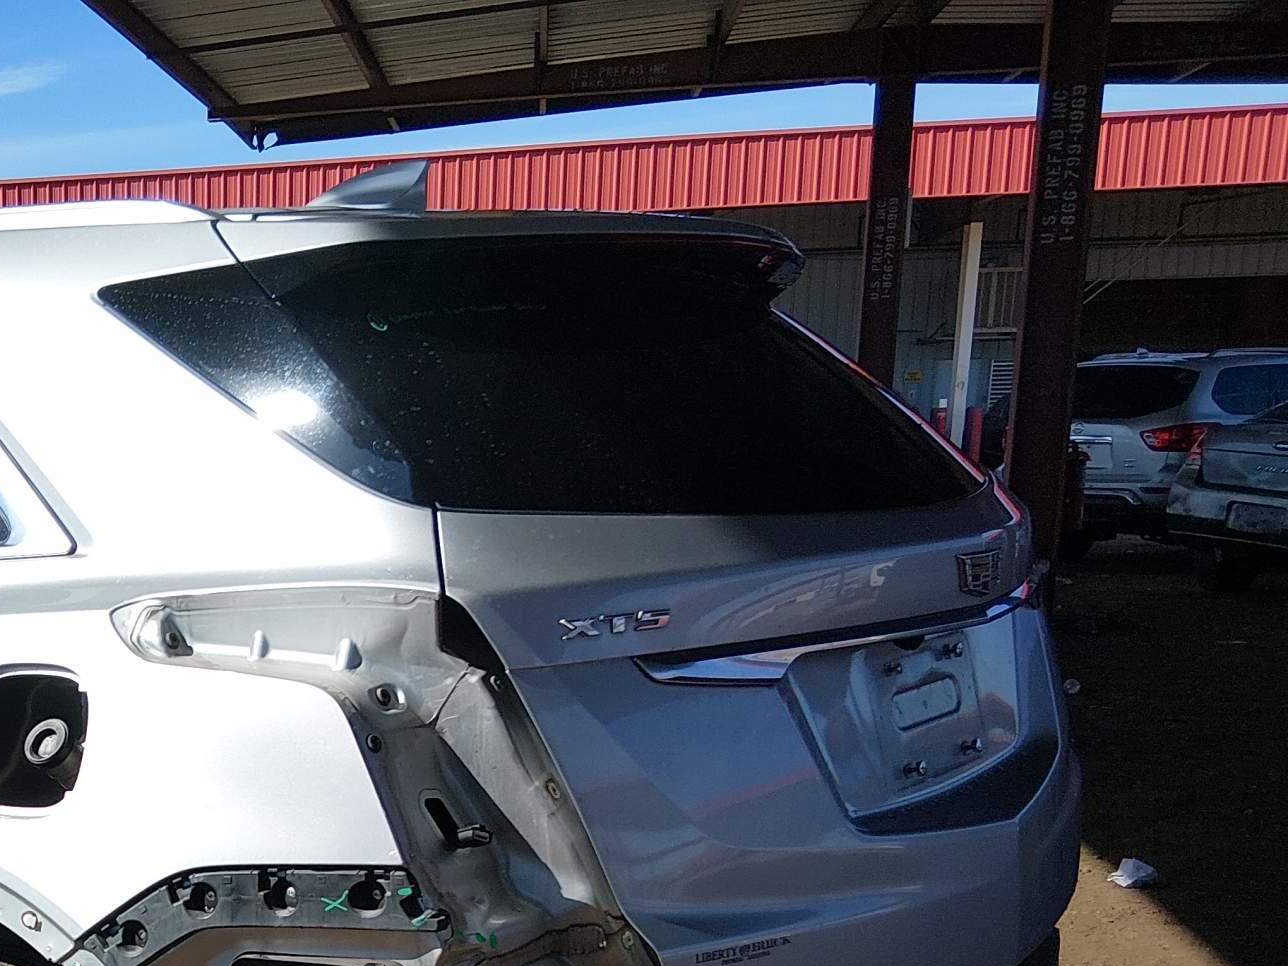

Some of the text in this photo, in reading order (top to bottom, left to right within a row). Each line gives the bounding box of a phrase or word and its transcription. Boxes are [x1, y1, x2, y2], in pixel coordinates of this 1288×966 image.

[1044, 129, 1064, 200] PREFAB
[1059, 84, 1088, 241] 1-866-799-0969
[872, 225, 884, 272] PREFAB
[558, 608, 671, 640] XT5
[695, 945, 738, 965] LIBERTY
[752, 935, 792, 952] BUICK
